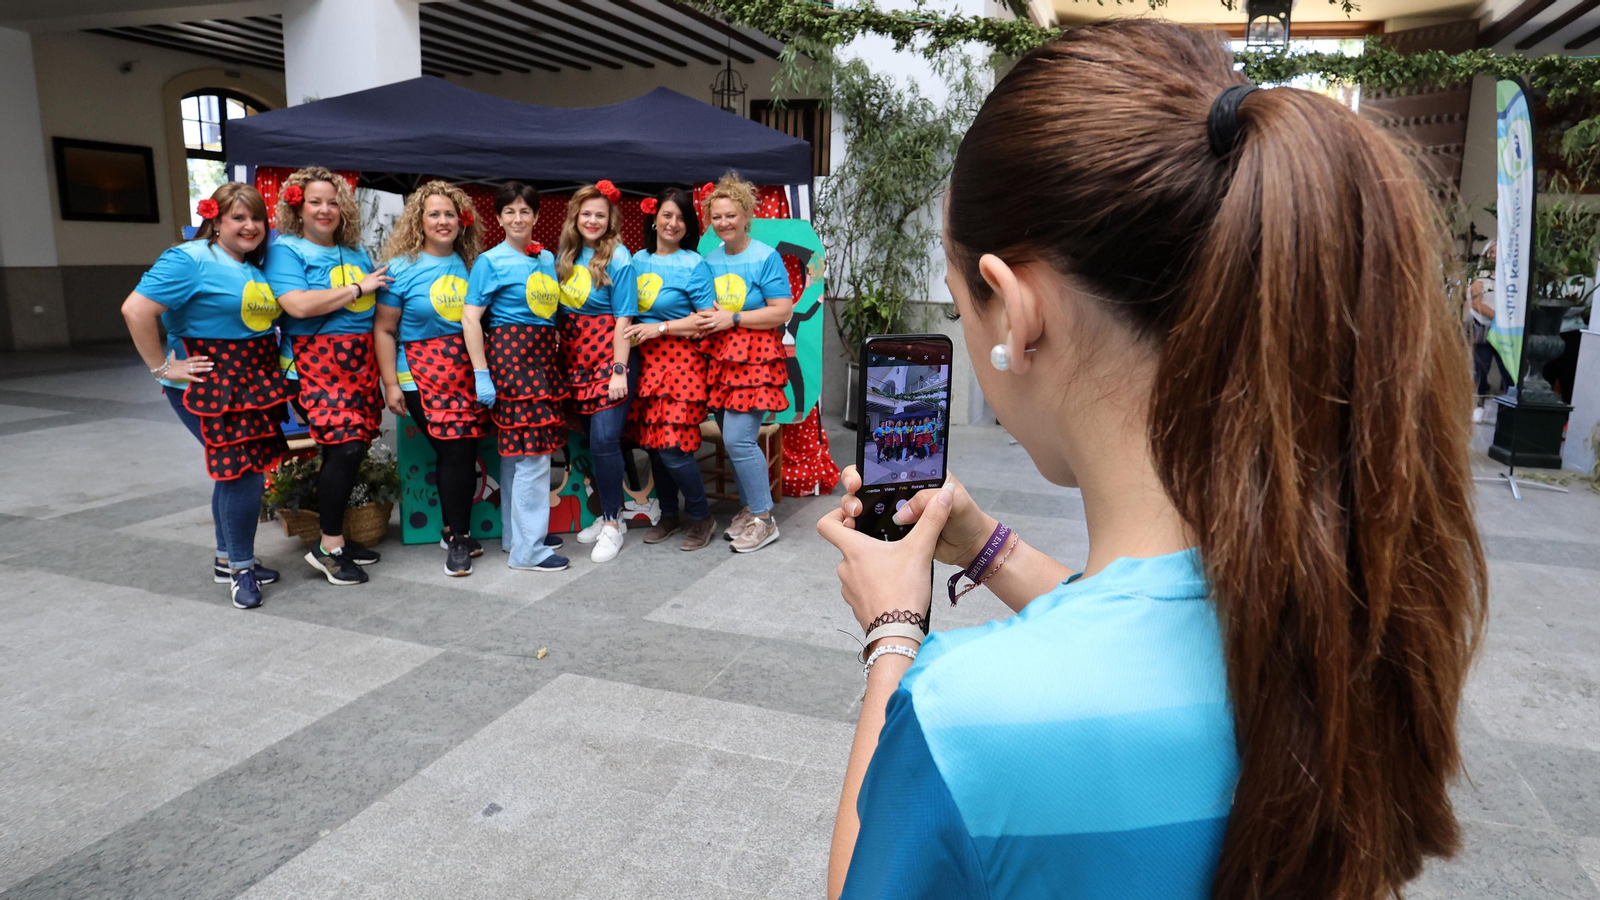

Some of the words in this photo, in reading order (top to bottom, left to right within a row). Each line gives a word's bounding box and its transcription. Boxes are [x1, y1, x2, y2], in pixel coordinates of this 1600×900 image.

[436, 293, 465, 304] Sher
[991, 535, 1002, 548] EN
[984, 547, 994, 556] EL
[969, 556, 987, 579] HUERTO
